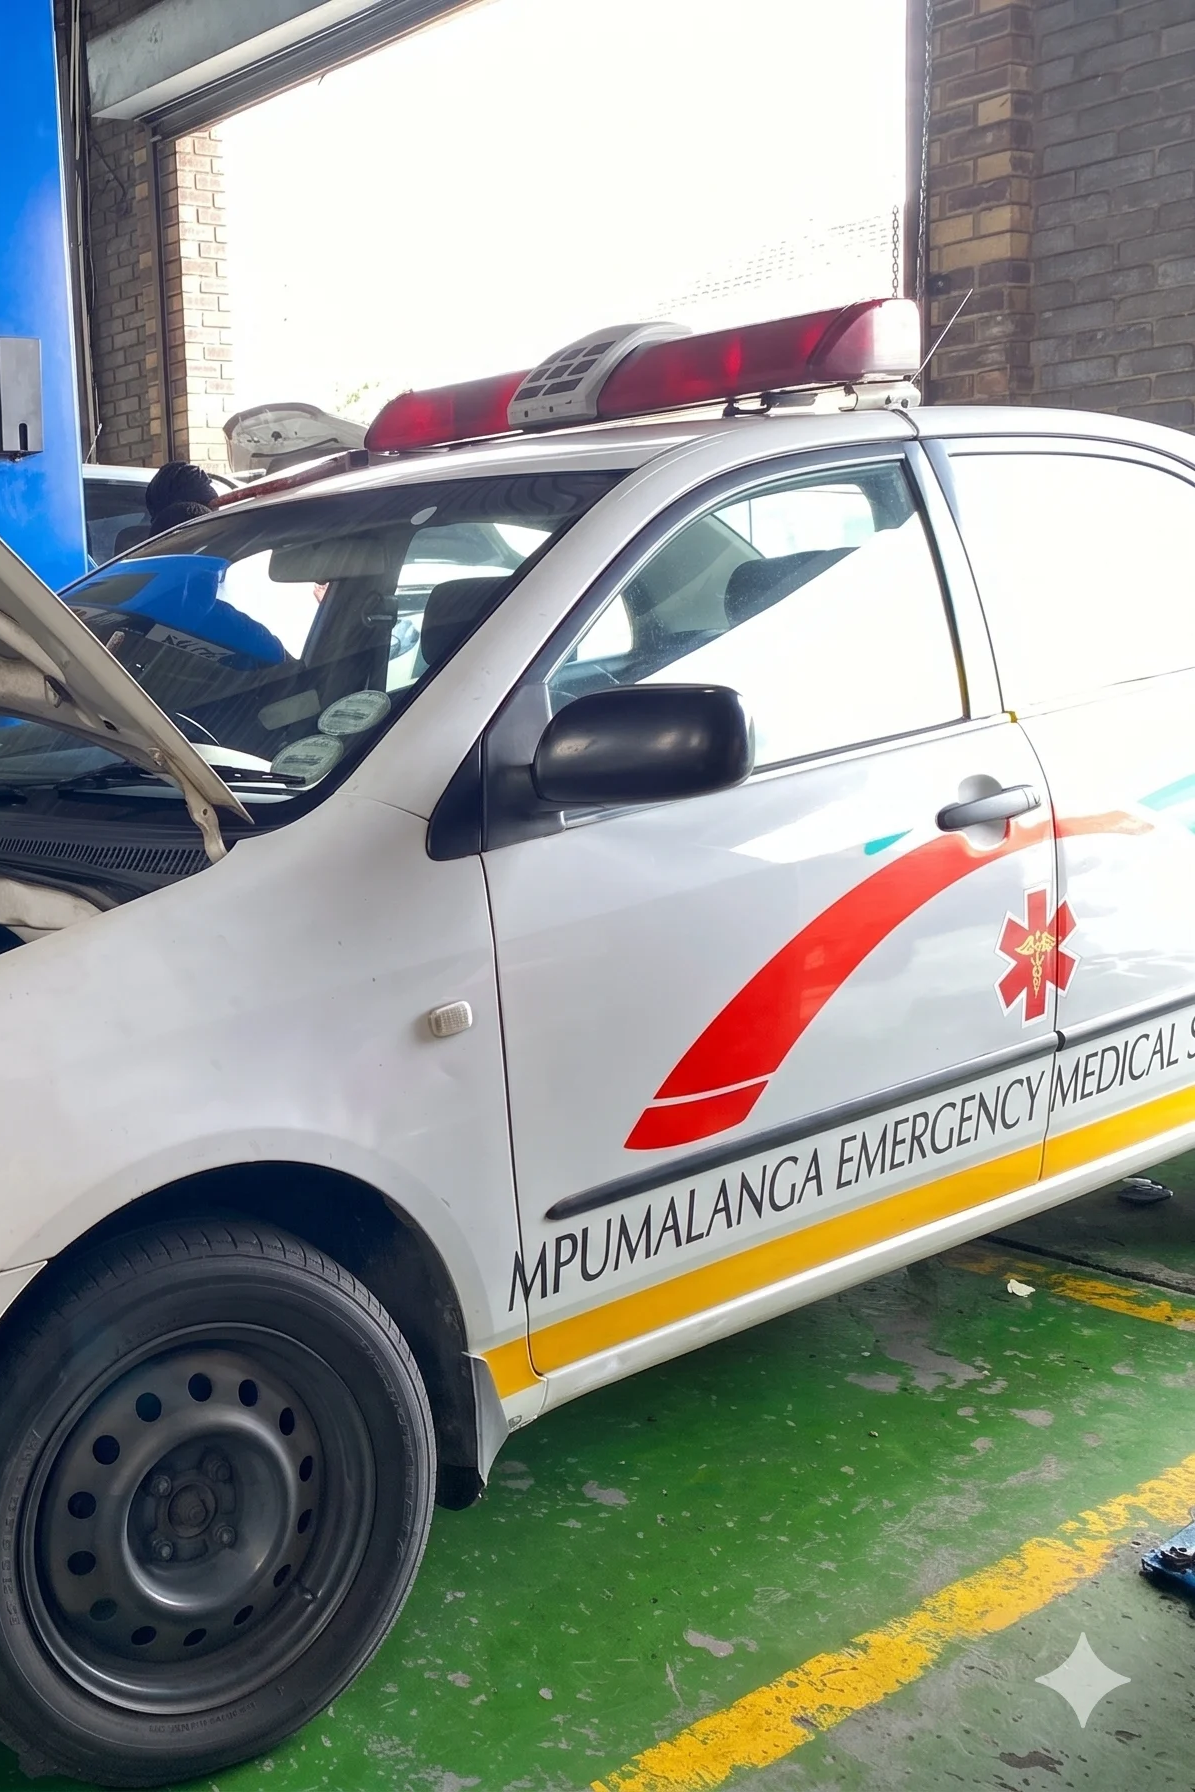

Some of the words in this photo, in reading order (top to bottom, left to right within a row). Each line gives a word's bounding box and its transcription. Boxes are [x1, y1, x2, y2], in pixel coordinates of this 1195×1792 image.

[508, 1149, 824, 1313] MPUMALANGA
[835, 1069, 1047, 1192] EMERGENCY
[1049, 1022, 1179, 1113] MEDICAL
